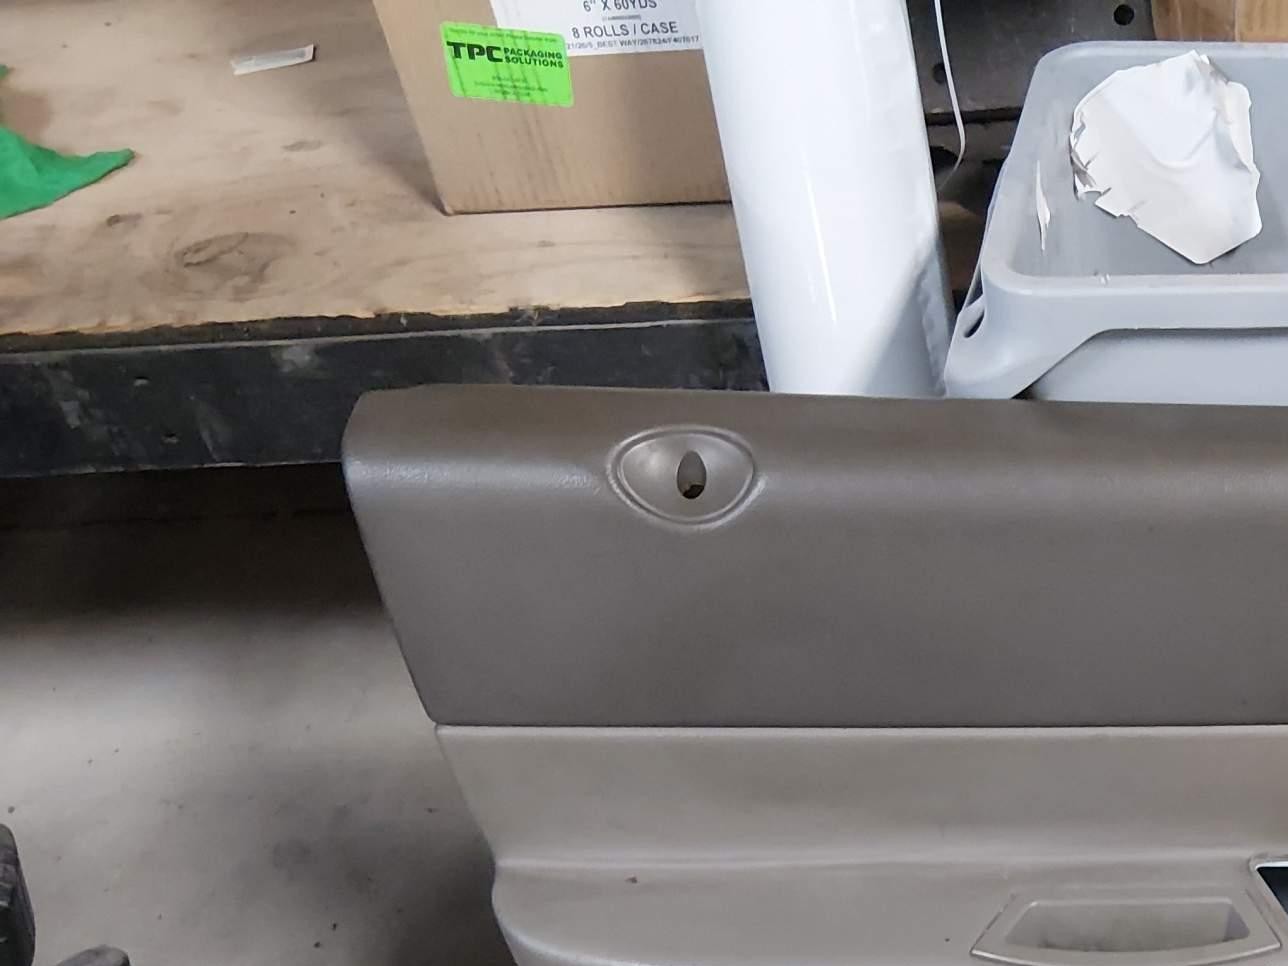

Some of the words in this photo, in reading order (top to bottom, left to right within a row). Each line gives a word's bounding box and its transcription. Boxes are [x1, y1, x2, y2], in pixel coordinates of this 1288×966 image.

[614, 0, 658, 11] 60YDS
[572, 26, 580, 39] 8
[584, 24, 629, 38] ROLLS
[641, 21, 679, 35] CASE
[446, 41, 503, 63] TPC
[503, 47, 563, 60] PACKAGING
[504, 56, 564, 69] SOLUTIONS
